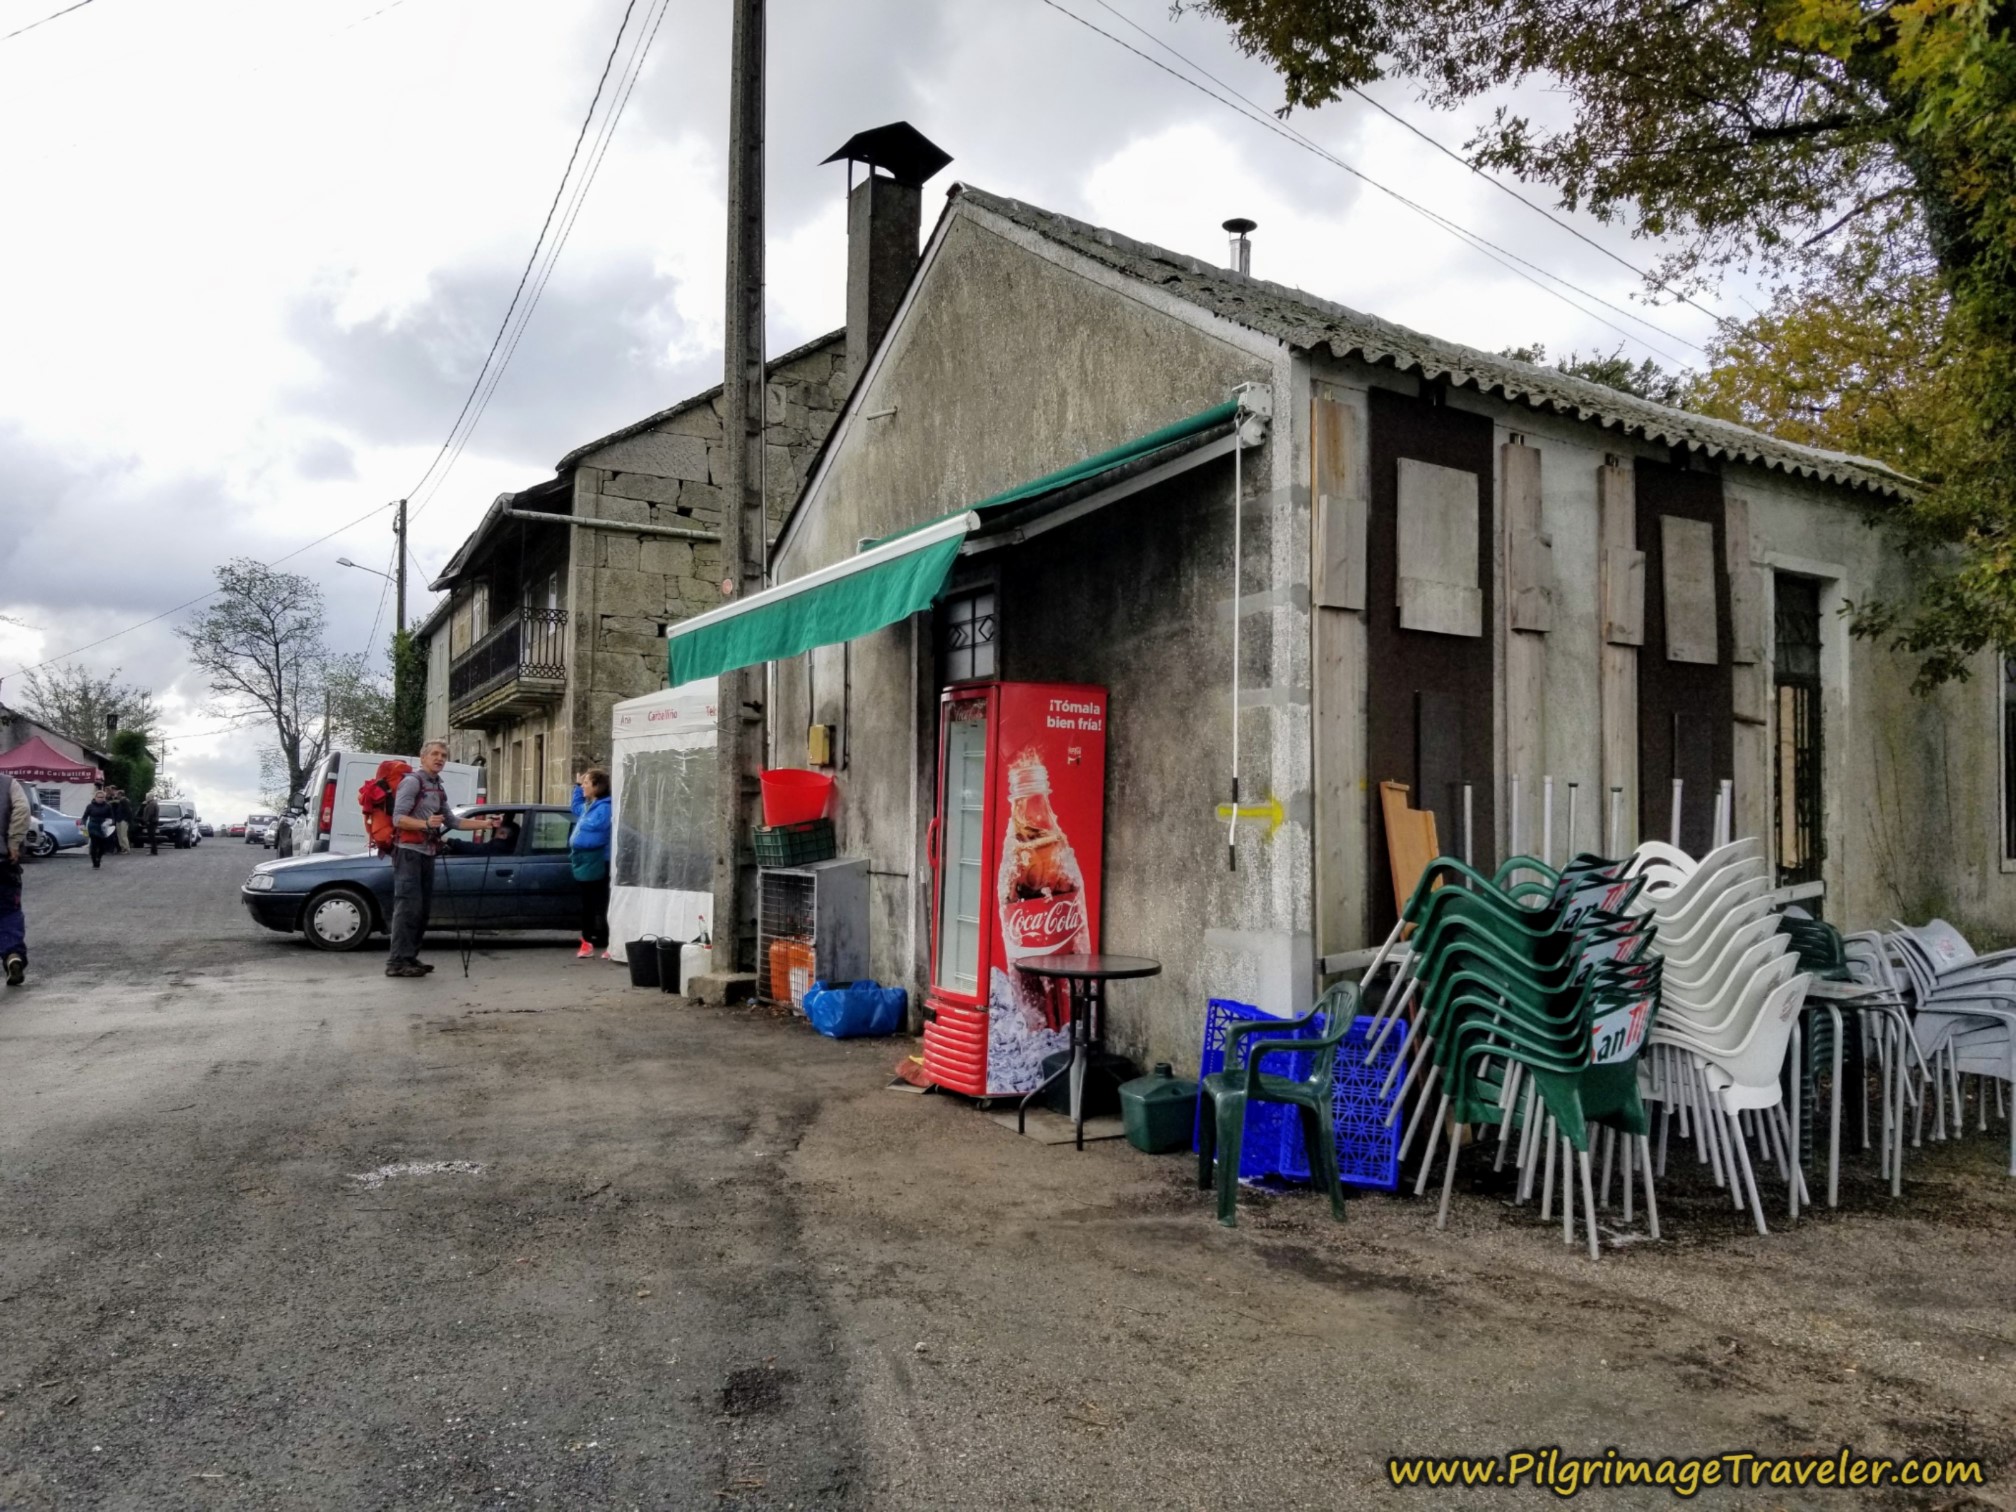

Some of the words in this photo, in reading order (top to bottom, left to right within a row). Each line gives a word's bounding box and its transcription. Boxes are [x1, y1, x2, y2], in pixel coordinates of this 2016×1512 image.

[1049, 699, 1101, 715] ¡Tómala
[1046, 715, 1076, 729] bien
[1078, 717, 1102, 731] fría!
[1009, 897, 1080, 940] Coca-Cola
